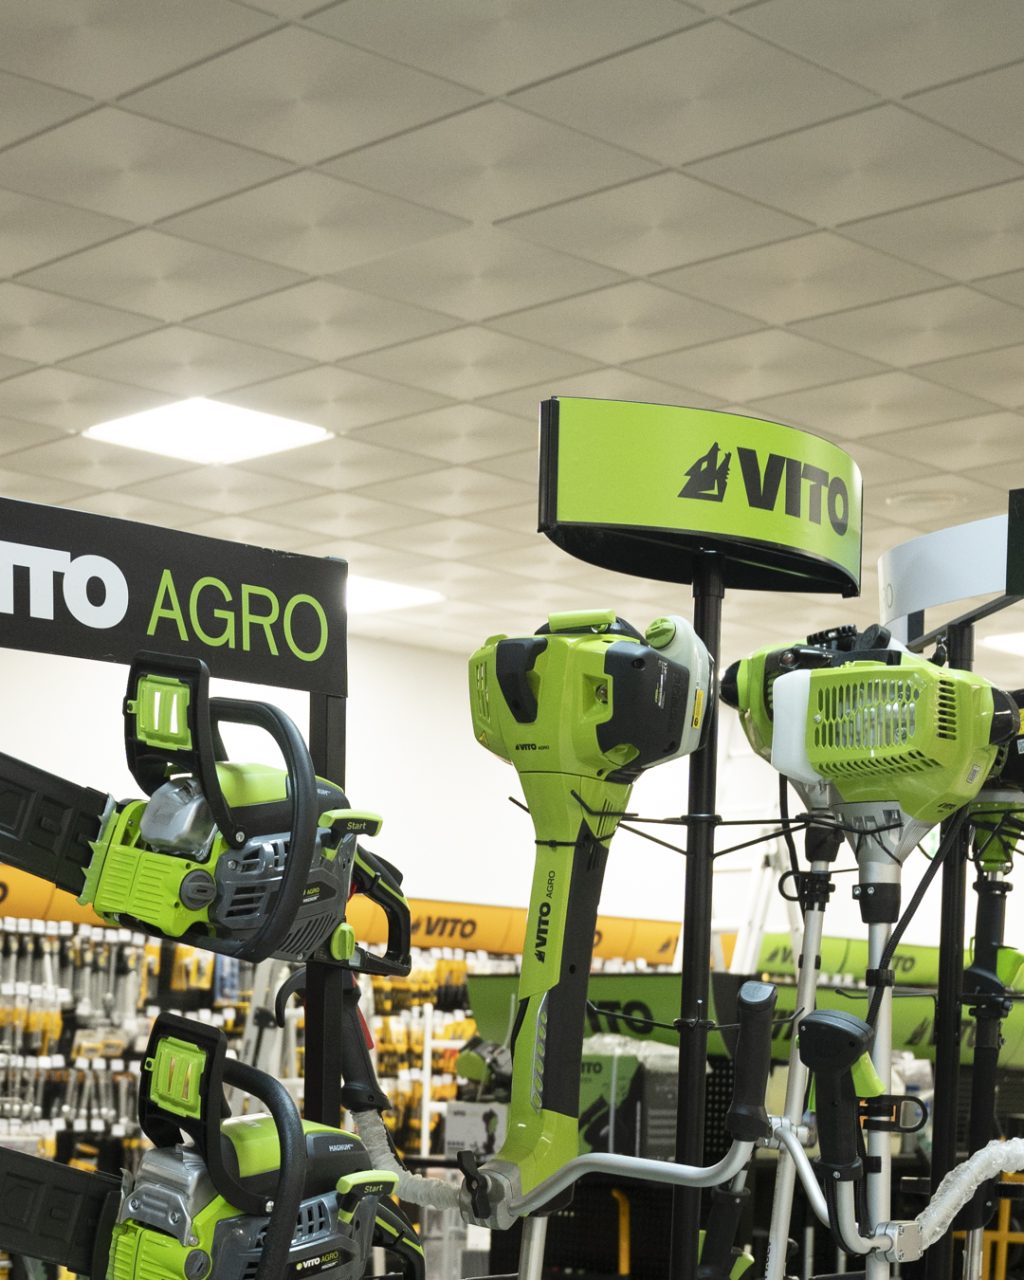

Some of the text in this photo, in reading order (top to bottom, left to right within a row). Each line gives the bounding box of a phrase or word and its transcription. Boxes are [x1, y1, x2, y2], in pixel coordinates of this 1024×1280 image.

[736, 446, 850, 536] VITO
[146, 568, 329, 662] AGRO
[520, 743, 537, 751] VITO
[346, 821, 367, 831] Start
[535, 870, 556, 949] VITO AGRO
[425, 916, 477, 939] VITO
[587, 1000, 654, 1035] ITO
[364, 1184, 383, 1194] Start
[303, 1251, 339, 1268] VITO AGRO
